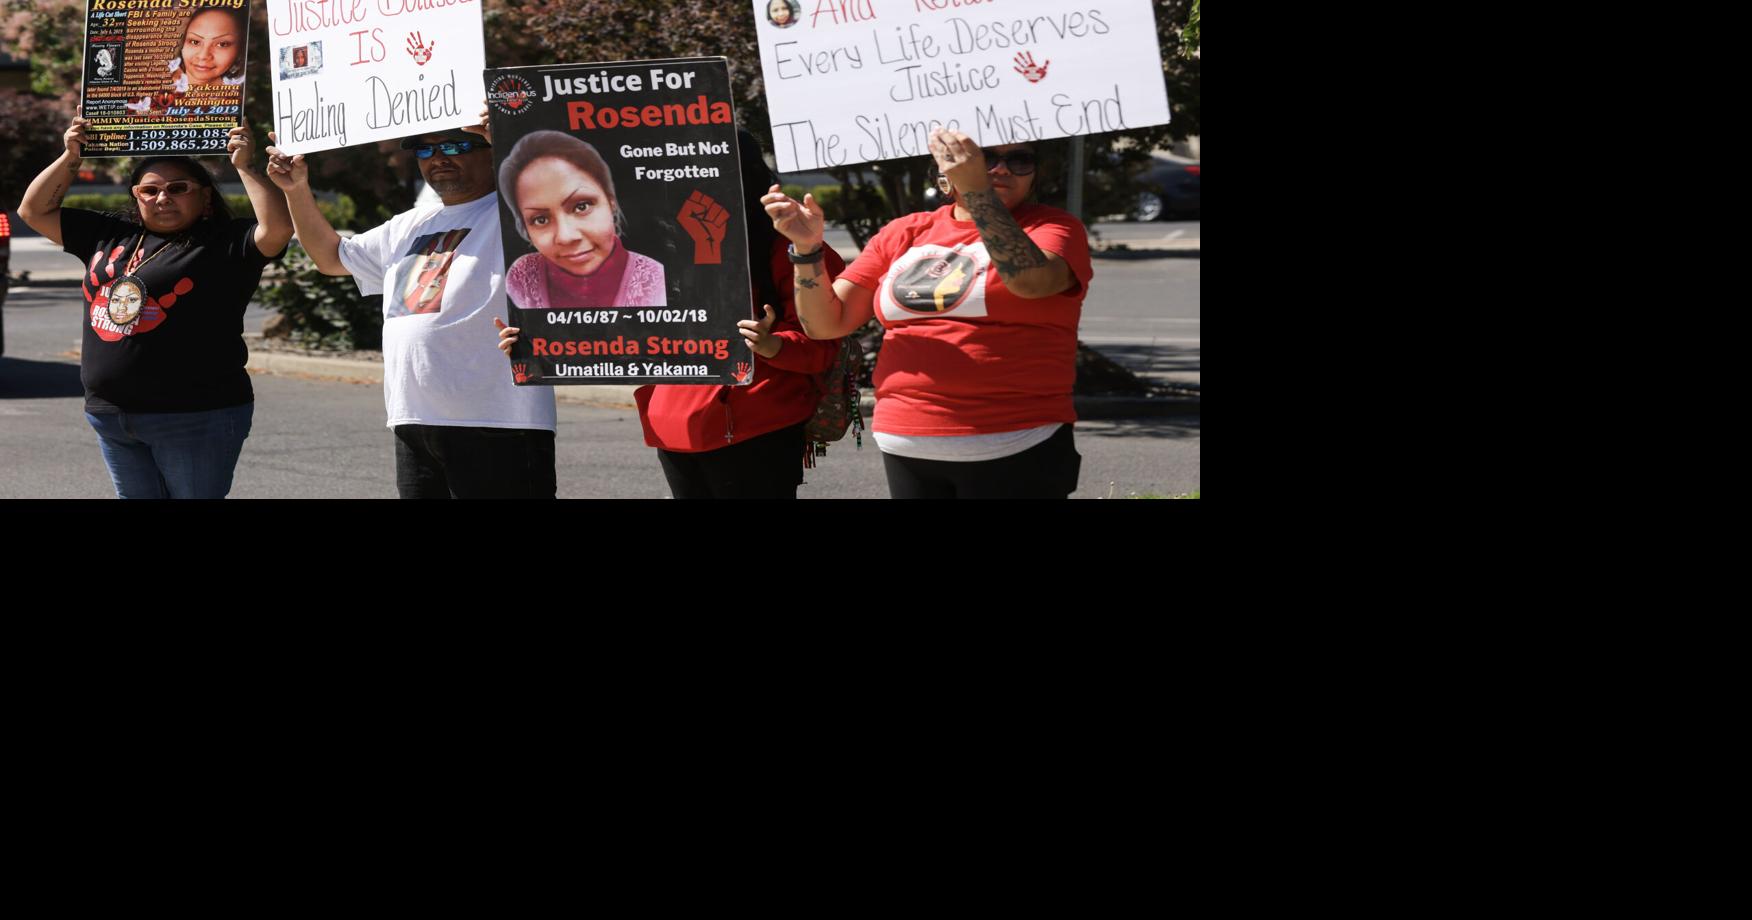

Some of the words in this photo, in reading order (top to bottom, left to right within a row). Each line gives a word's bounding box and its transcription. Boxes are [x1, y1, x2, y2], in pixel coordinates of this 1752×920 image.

[92, 0, 174, 10] Rosenda
[177, 0, 242, 9] Strong
[102, 18, 116, 27] 32
[127, 10, 144, 18] FBI
[152, 10, 179, 19] Family
[127, 19, 160, 27] Seeking
[348, 27, 386, 66] IS
[775, 41, 862, 80] Every
[873, 23, 941, 65] Life
[944, 10, 1110, 55] Deserves
[542, 70, 642, 102] Justice
[650, 68, 695, 91] For
[889, 61, 1000, 102] Justice
[185, 90, 239, 98] Reservation
[166, 105, 190, 116] July
[193, 106, 204, 114] 4,
[207, 104, 238, 114] 2019
[174, 98, 238, 107] Washington
[277, 81, 347, 146] Healing
[364, 69, 461, 130] Denied
[567, 95, 732, 130] Rosenda
[128, 129, 229, 140] 1.509.990.085
[772, 119, 847, 171] The
[855, 113, 960, 162] Silen
[975, 99, 1043, 147] Must
[1051, 83, 1132, 137] End
[100, 132, 127, 141] Tipline:
[128, 140, 226, 151] 1.509.865.293
[620, 144, 663, 158] Gone
[665, 142, 697, 157] But
[698, 141, 730, 155] Not
[635, 165, 720, 182] Forgotten
[547, 311, 618, 325] 04/16/87
[636, 309, 708, 323] 10/02/18
[91, 317, 134, 336] STRONG
[532, 335, 640, 356] Rosenda
[646, 336, 729, 360] Strong
[555, 362, 624, 377] Umatilla
[627, 362, 639, 377] &
[642, 361, 708, 377] Yakama
